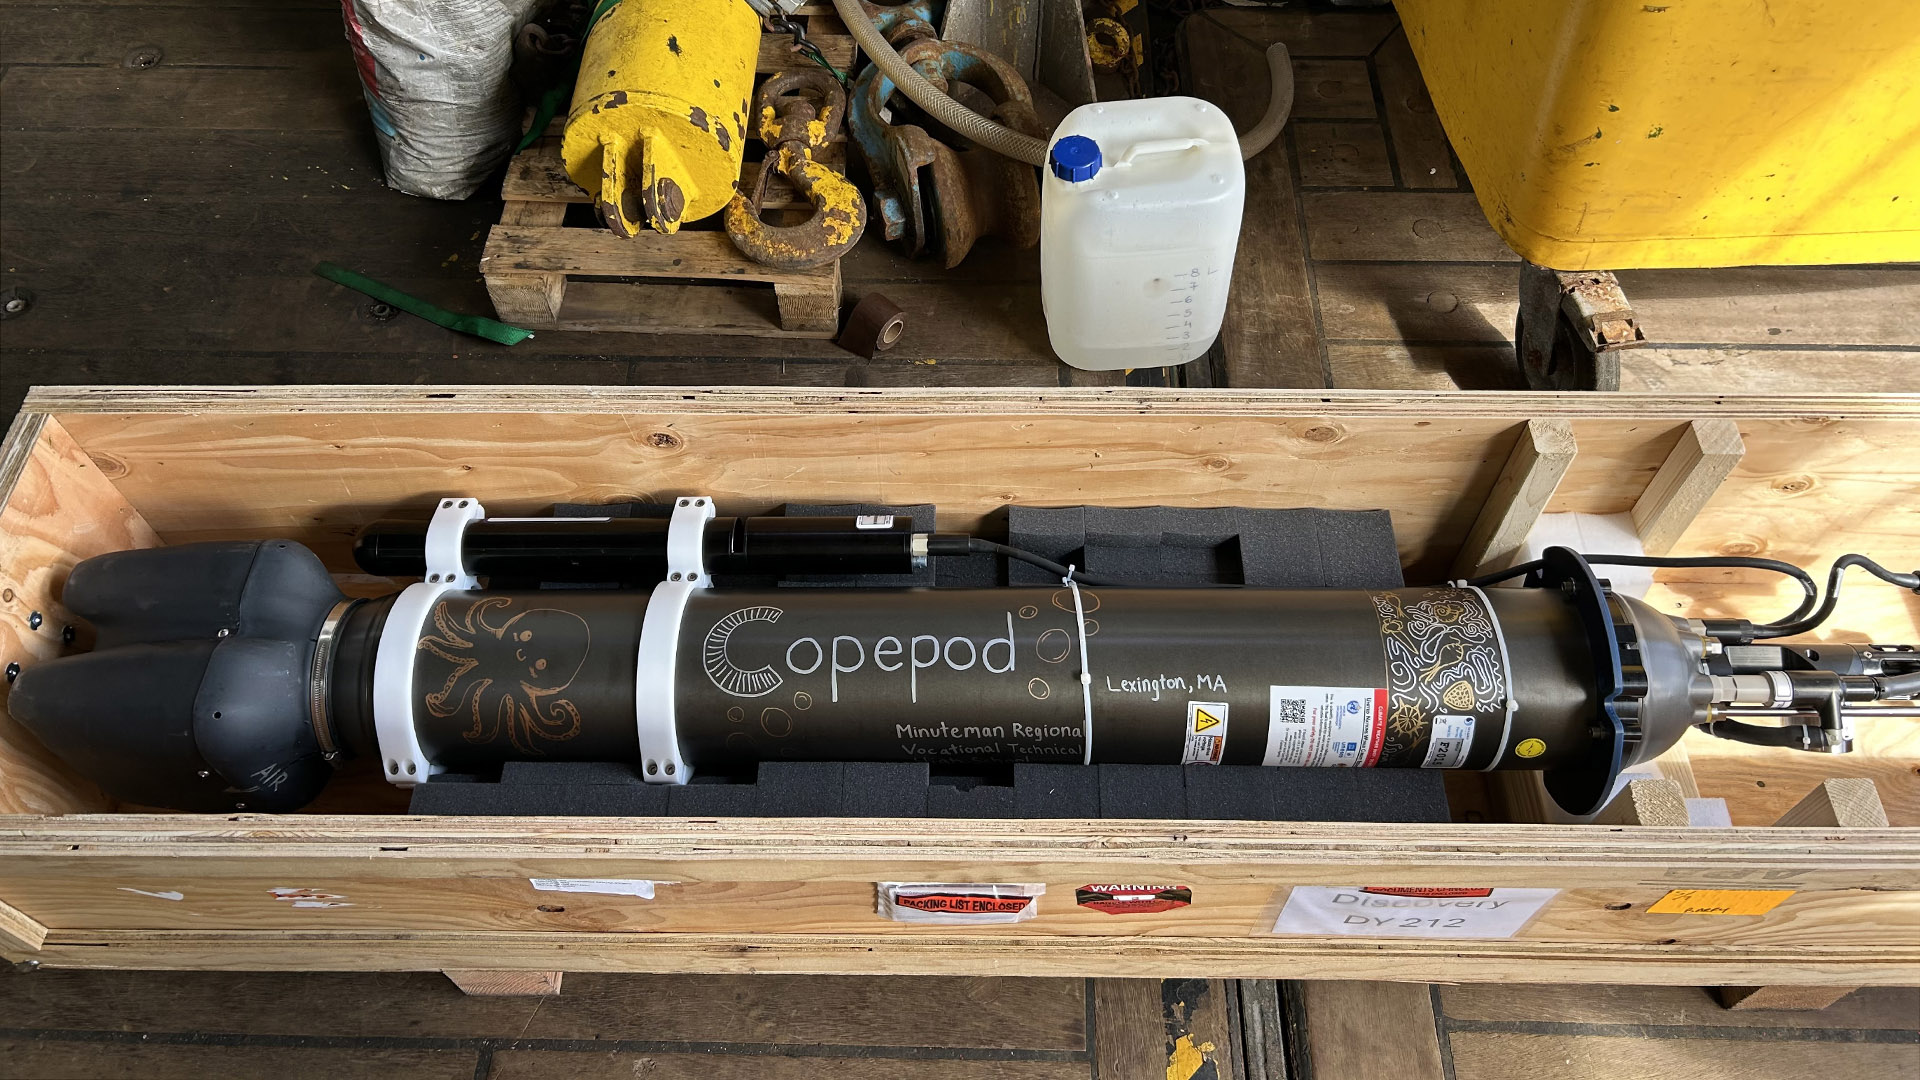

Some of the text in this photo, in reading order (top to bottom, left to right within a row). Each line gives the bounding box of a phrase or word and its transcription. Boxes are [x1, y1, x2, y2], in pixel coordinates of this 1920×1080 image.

[1190, 267, 1200, 278] 8
[1189, 281, 1200, 291] 7
[1184, 295, 1193, 304] 6
[1183, 308, 1193, 318] 5
[1183, 320, 1192, 329] 4
[1182, 331, 1191, 340] 3
[1182, 342, 1190, 351] 2
[703, 606, 1016, 703] Copepod
[1106, 673, 1228, 701] Lexington, MA
[1376, 705, 1384, 726] CLIMATE
[895, 719, 1086, 742] Minuteman Regional
[901, 742, 1083, 756] Vocational Technical
[250, 763, 289, 792] AIR
[903, 900, 1026, 912] PACKING LIST ENCLOSED
[1332, 893, 1511, 910] Discovery
[1343, 915, 1466, 928] DY 212
